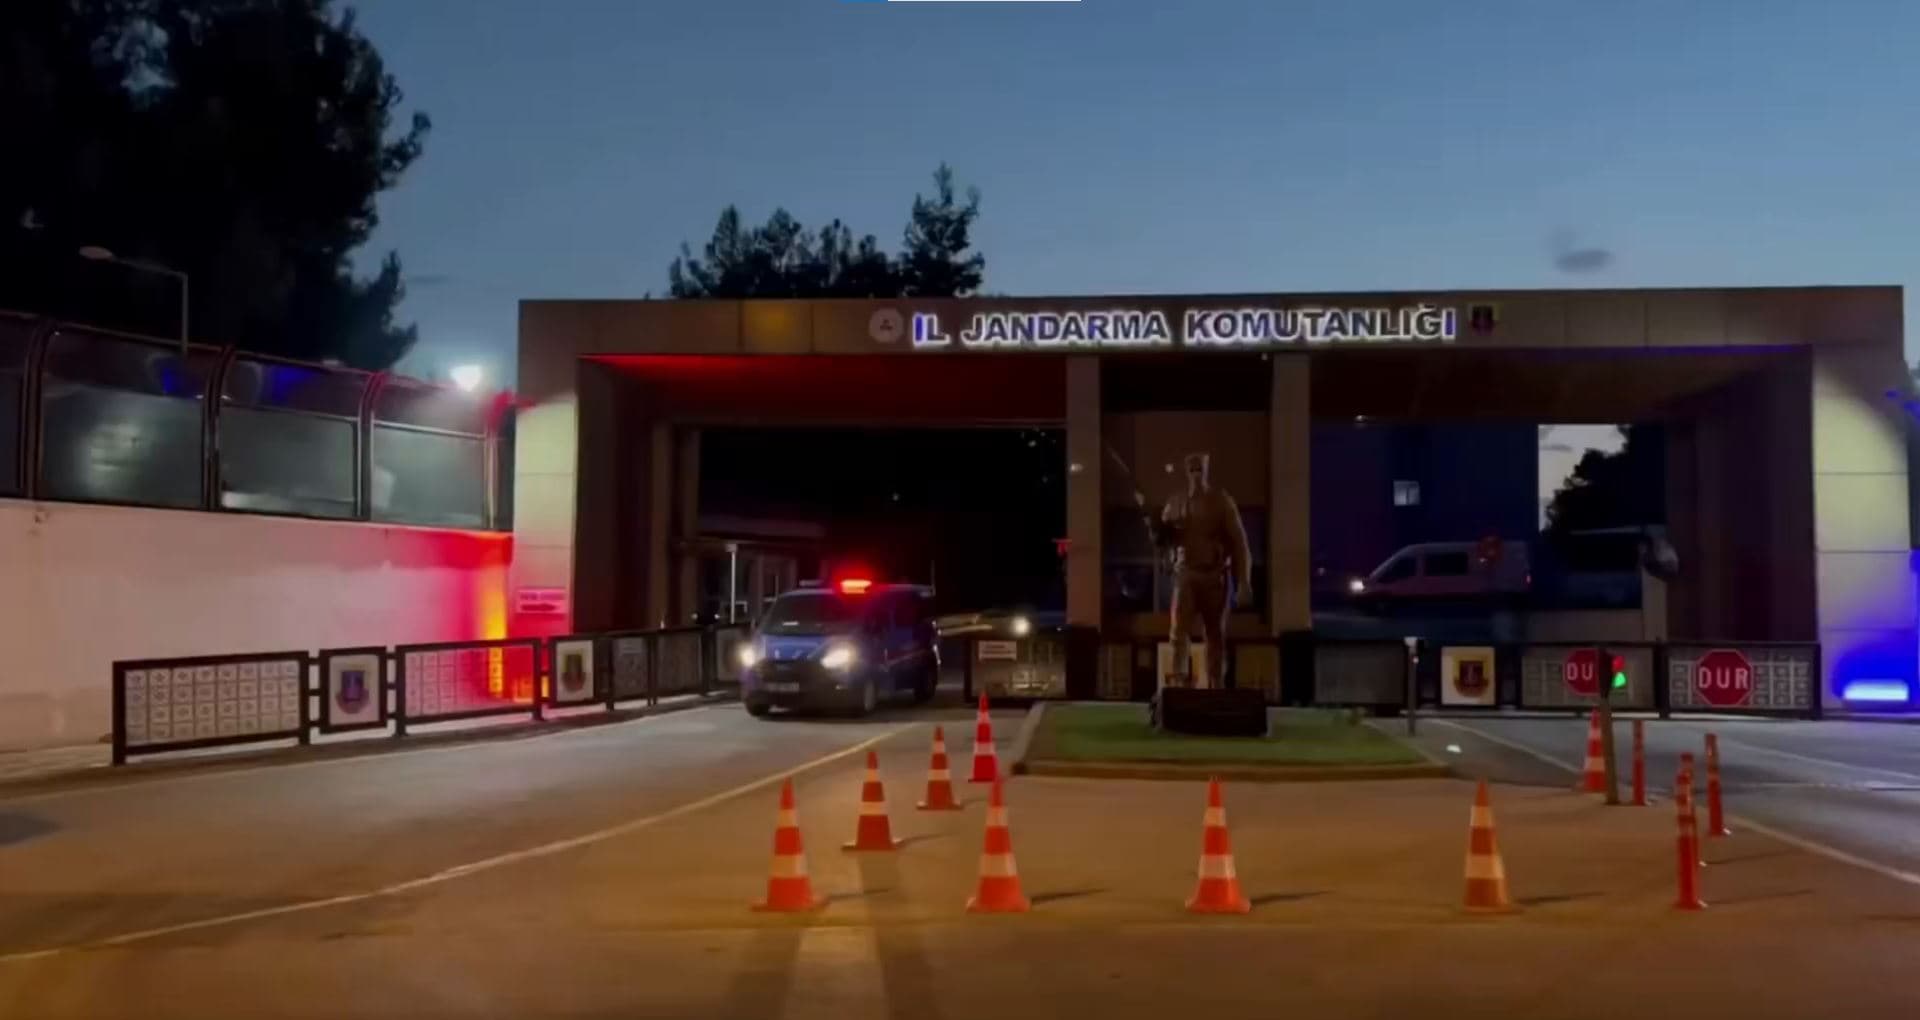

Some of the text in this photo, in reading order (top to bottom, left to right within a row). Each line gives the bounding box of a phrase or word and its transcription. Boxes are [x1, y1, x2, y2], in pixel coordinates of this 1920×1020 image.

[962, 311, 1170, 345] JANDARMA
[1185, 304, 1456, 343] KOMUTANLIĞI
[1566, 662, 1595, 681] DU
[1698, 666, 1750, 689] DUR
